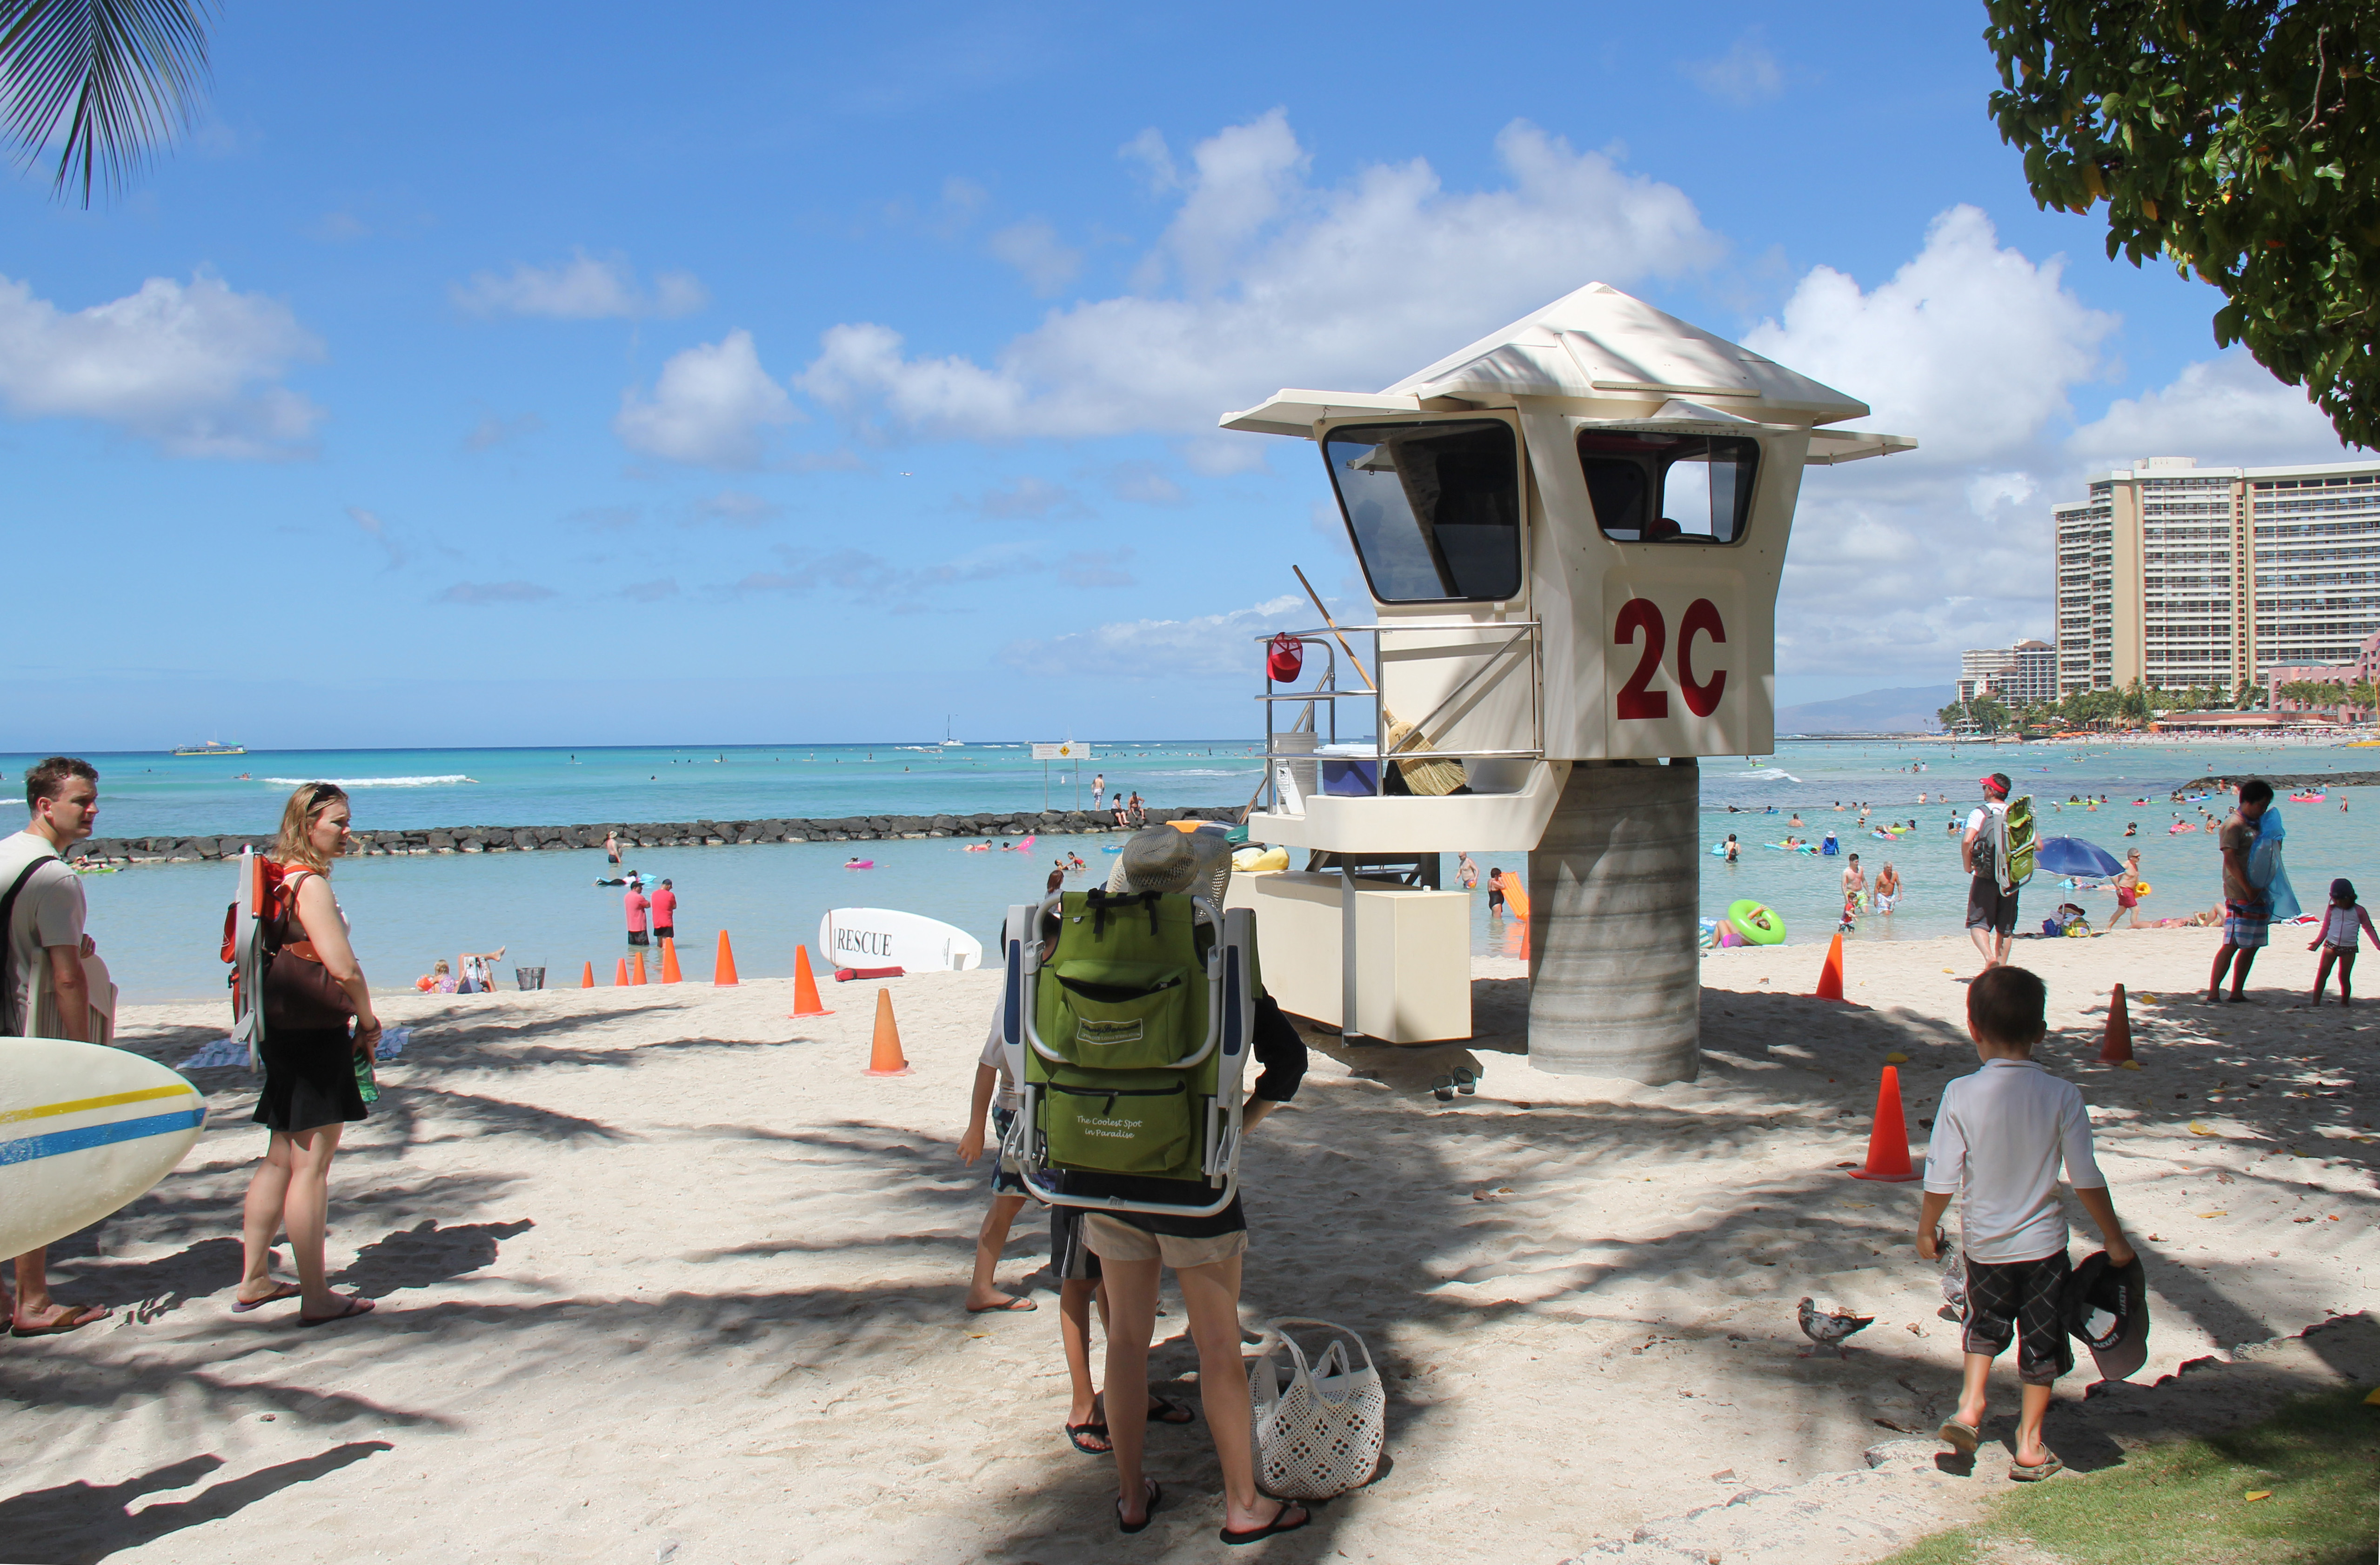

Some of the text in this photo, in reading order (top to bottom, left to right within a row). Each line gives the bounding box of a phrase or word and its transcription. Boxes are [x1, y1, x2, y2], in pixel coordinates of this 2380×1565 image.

[1614, 597, 1727, 720] 2C
[837, 928, 892, 956] RESCUE
[1077, 1115, 1143, 1129] The Coolest Spot
[1096, 1129, 1135, 1138] Paradise
